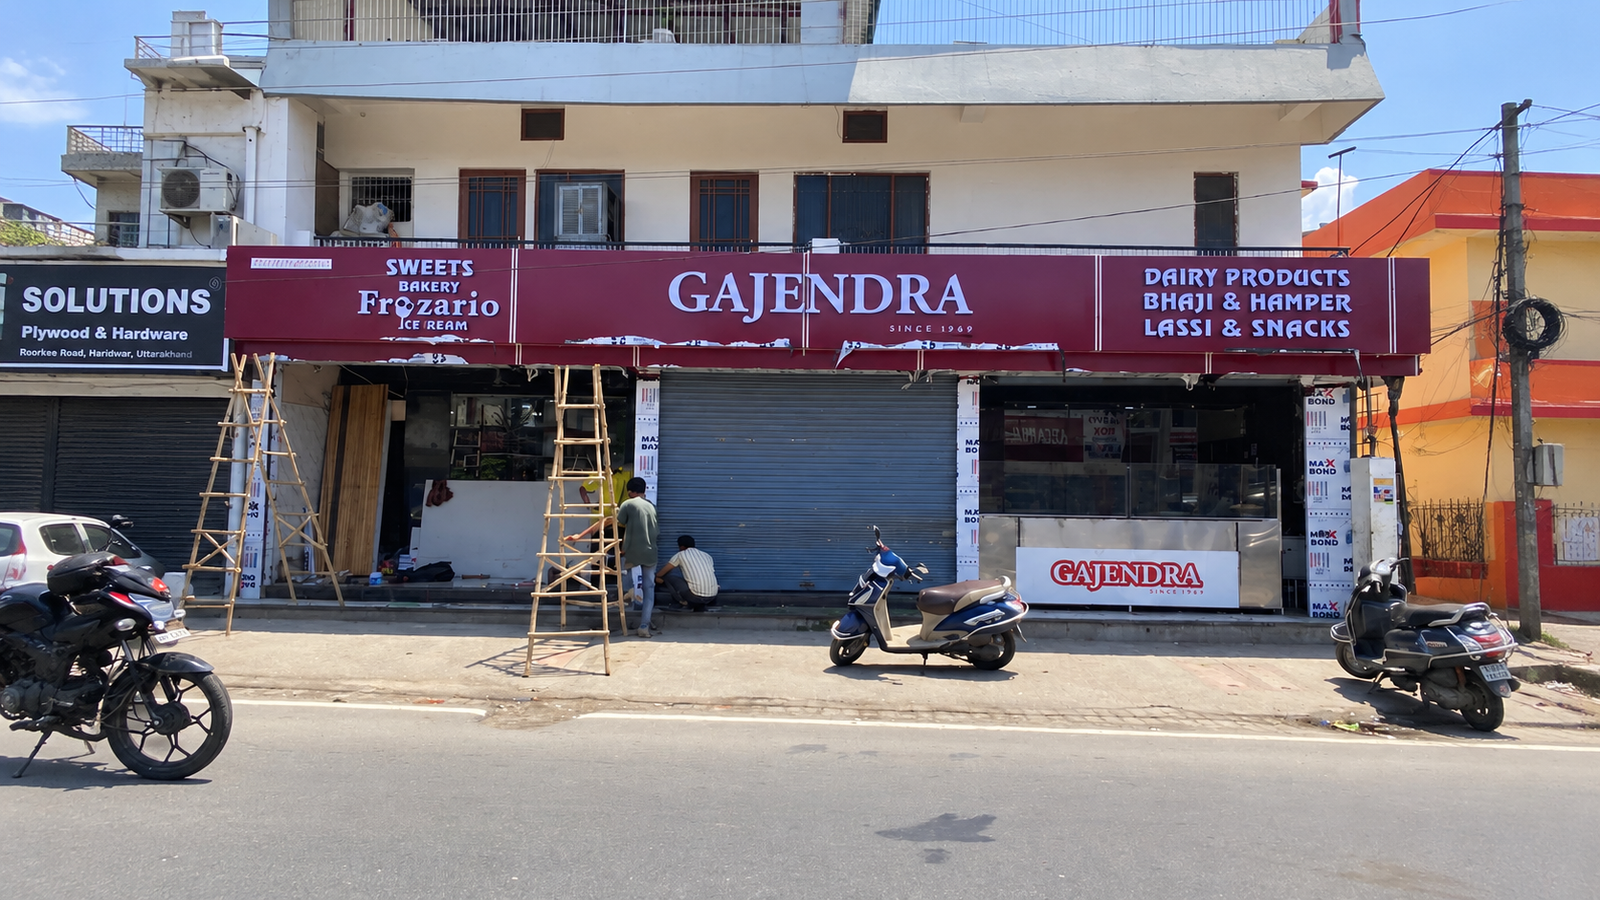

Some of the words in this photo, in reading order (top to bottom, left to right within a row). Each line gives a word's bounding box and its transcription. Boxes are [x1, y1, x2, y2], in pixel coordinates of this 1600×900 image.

[386, 258, 474, 277] SWEETS
[399, 280, 460, 293] BAKERY
[1143, 268, 1218, 288] DAIRY
[1225, 268, 1351, 287] PRODUCTS
[22, 286, 211, 315] SOLUTIONS
[357, 290, 500, 319] Frozario
[668, 270, 974, 324] GAJENDRA
[1143, 292, 1213, 314] BHAJI
[1222, 291, 1241, 312] &
[1250, 292, 1352, 313] HAMPER
[21, 325, 90, 341] Plywood
[94, 326, 108, 340] &
[112, 327, 188, 341] Hardware
[422, 320, 468, 331] REAM
[889, 324, 932, 333] SINCE
[941, 325, 973, 333] 1969
[1143, 318, 1212, 339] LASSI
[1221, 318, 1242, 338] &
[1251, 319, 1351, 339] SNACKS
[19, 348, 58, 357] Roorkee
[60, 349, 87, 359] Road,
[89, 349, 134, 359] Haridwar,
[136, 350, 193, 359] Uttarakhand
[1308, 458, 1336, 468] MAX
[1051, 560, 1204, 592] GAJENDRA
